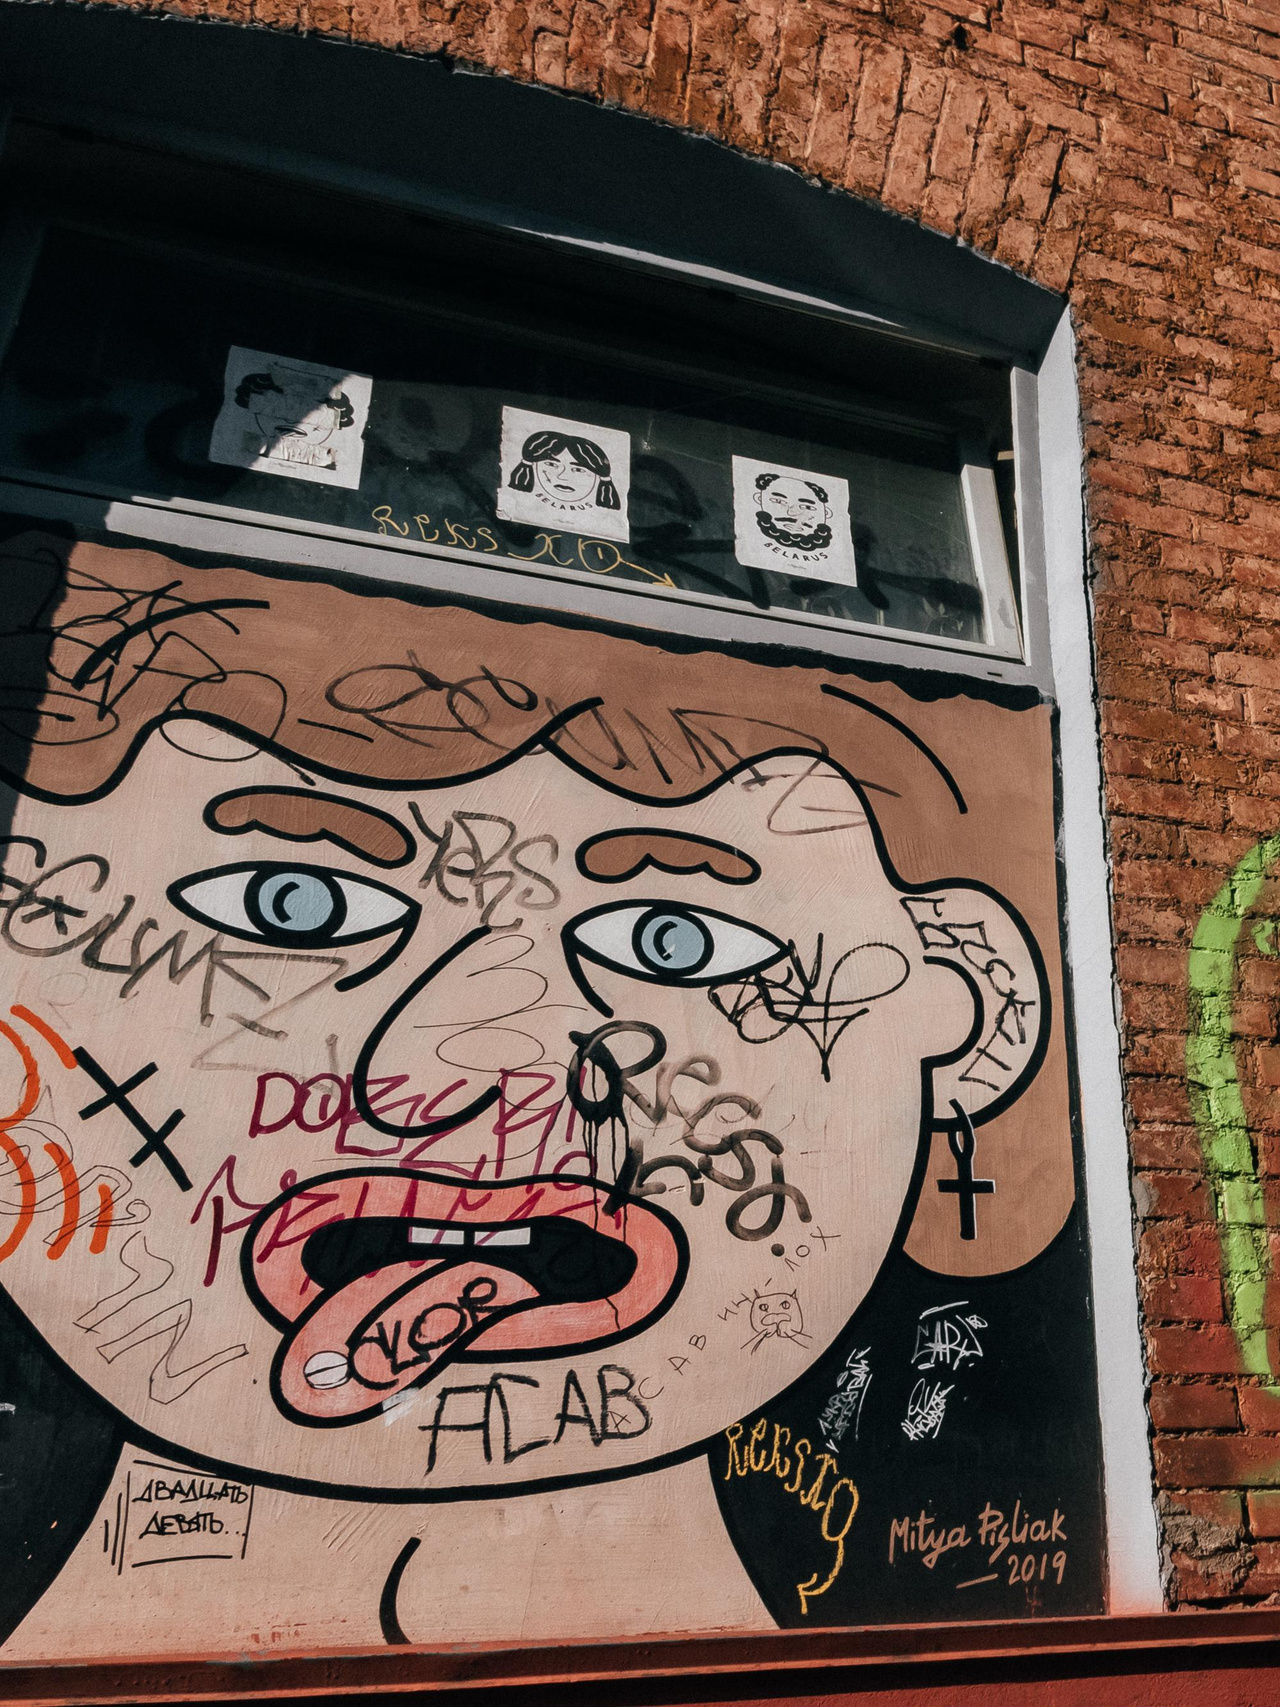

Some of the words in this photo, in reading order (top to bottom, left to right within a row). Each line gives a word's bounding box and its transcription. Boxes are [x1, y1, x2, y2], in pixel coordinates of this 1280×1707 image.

[535, 493, 593, 511] BELARUS
[764, 542, 828, 561] BELARUS
[418, 1364, 653, 1477] ACAB
[888, 1509, 972, 1569] Mitya
[1007, 1550, 1067, 1586] 2019
